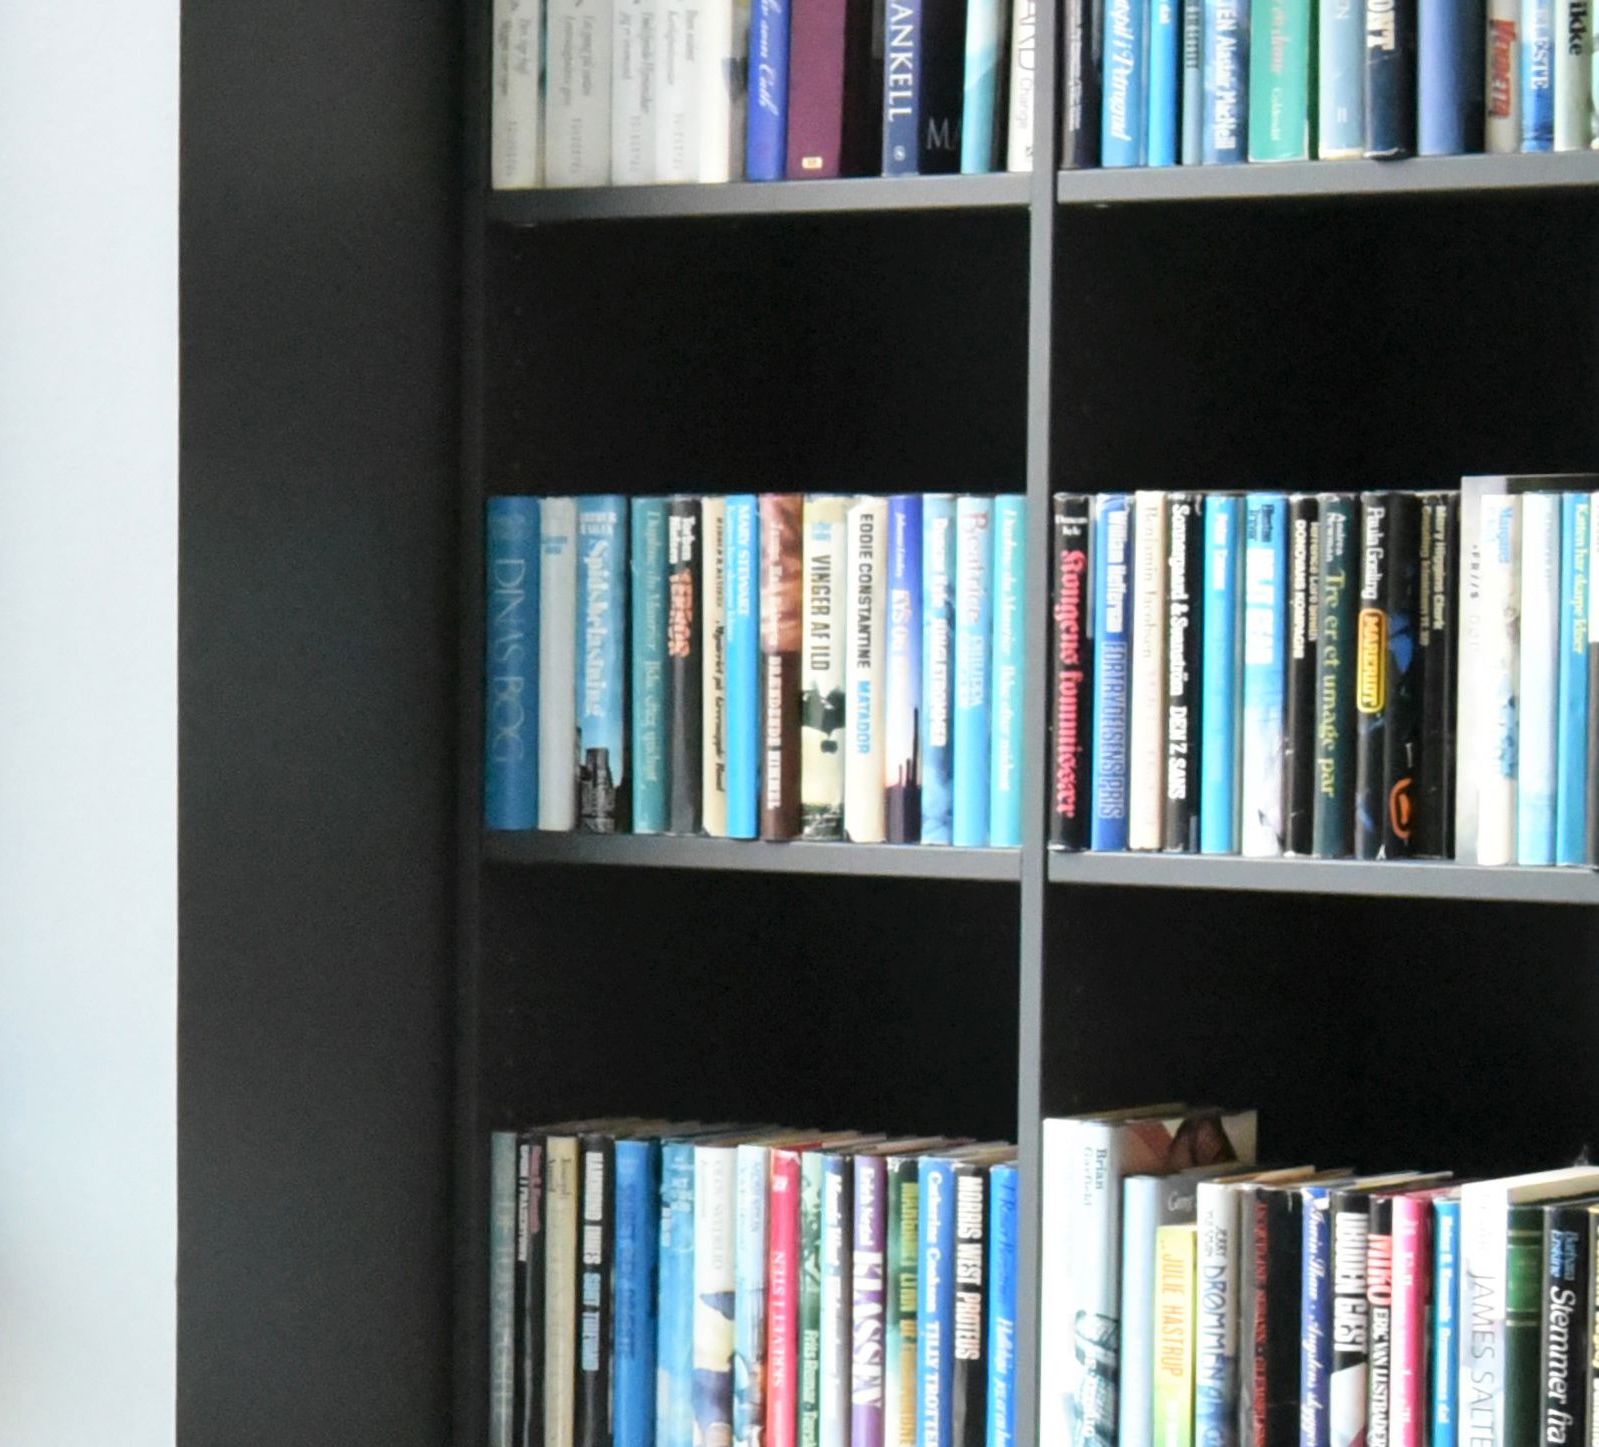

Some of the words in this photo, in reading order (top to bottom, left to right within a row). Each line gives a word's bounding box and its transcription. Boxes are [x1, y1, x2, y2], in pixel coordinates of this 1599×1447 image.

[1569, 2, 1588, 56] ikke
[888, 0, 914, 124] ANKELL
[1110, 50, 1133, 142] Petrograd
[737, 504, 750, 547] MARY
[857, 513, 874, 560] EDDIE
[1142, 506, 1157, 583] Benjamin
[1325, 511, 1337, 562] Newman
[1335, 512, 1347, 556] Andrea
[1364, 506, 1384, 546] Paula
[1432, 505, 1446, 541] Mary
[1497, 506, 1513, 564] Margaret
[1571, 503, 1588, 547] Katten
[1293, 519, 1307, 590] DONOVANS
[1364, 546, 1384, 600] Gosling
[1432, 542, 1446, 593] Higgins
[1571, 548, 1588, 570] har
[737, 549, 750, 617] STEWART
[810, 554, 832, 617] VINGER
[1054, 549, 1086, 665] Kongens
[1169, 602, 1188, 615] &
[1325, 568, 1346, 608] Tre
[1571, 573, 1588, 617] skarpe
[493, 558, 526, 662] DINAS
[583, 539, 611, 718] Spidsbelastning
[810, 621, 832, 640] AF
[857, 562, 874, 669] CONSTANTINE
[1142, 590, 1157, 658] Jacobsen
[1293, 591, 1307, 660] KOMPAGNI
[1324, 615, 1339, 641] er
[1432, 594, 1446, 630] Clark
[810, 645, 832, 672] ILD
[1323, 645, 1341, 669] et
[493, 676, 526, 764] BOG
[857, 680, 874, 755] MATADOR
[1169, 705, 1188, 742] DEN
[1319, 674, 1338, 751] umage
[1098, 775, 1128, 819] PRIS
[1169, 757, 1188, 800] SANS
[1317, 757, 1337, 799] par
[1096, 1148, 1108, 1191] Brian
[926, 1170, 943, 1243] Catherine
[957, 1176, 983, 1239] MORRIS
[1302, 1208, 1323, 1253] Irwin
[772, 1251, 787, 1296] STEN
[957, 1242, 983, 1285] WEST
[1161, 1253, 1185, 1296] JULIE
[1302, 1254, 1323, 1301] Shaw
[1366, 1233, 1392, 1306] MIKO
[1549, 1228, 1565, 1279] Erskine
[1564, 1230, 1578, 1281] Barbara
[926, 1246, 943, 1313] Cookson
[852, 1249, 883, 1409] KLASSEN
[957, 1291, 983, 1360] PROTEUS
[1201, 1264, 1228, 1382] DRØMMEN
[1333, 1296, 1368, 1354] GÆST
[1370, 1307, 1389, 1341] ERIC
[1469, 1271, 1495, 1359] JAMES
[772, 1310, 787, 1388] SKREVET
[926, 1320, 943, 1371] TILLY
[1161, 1305, 1185, 1378] HASTRUP
[1302, 1314, 1323, 1389] Angstens
[1370, 1342, 1389, 1366] VAN
[1544, 1285, 1576, 1404] Stemmer
[1302, 1391, 1323, 1447] skygger
[1544, 1407, 1576, 1443] fra
